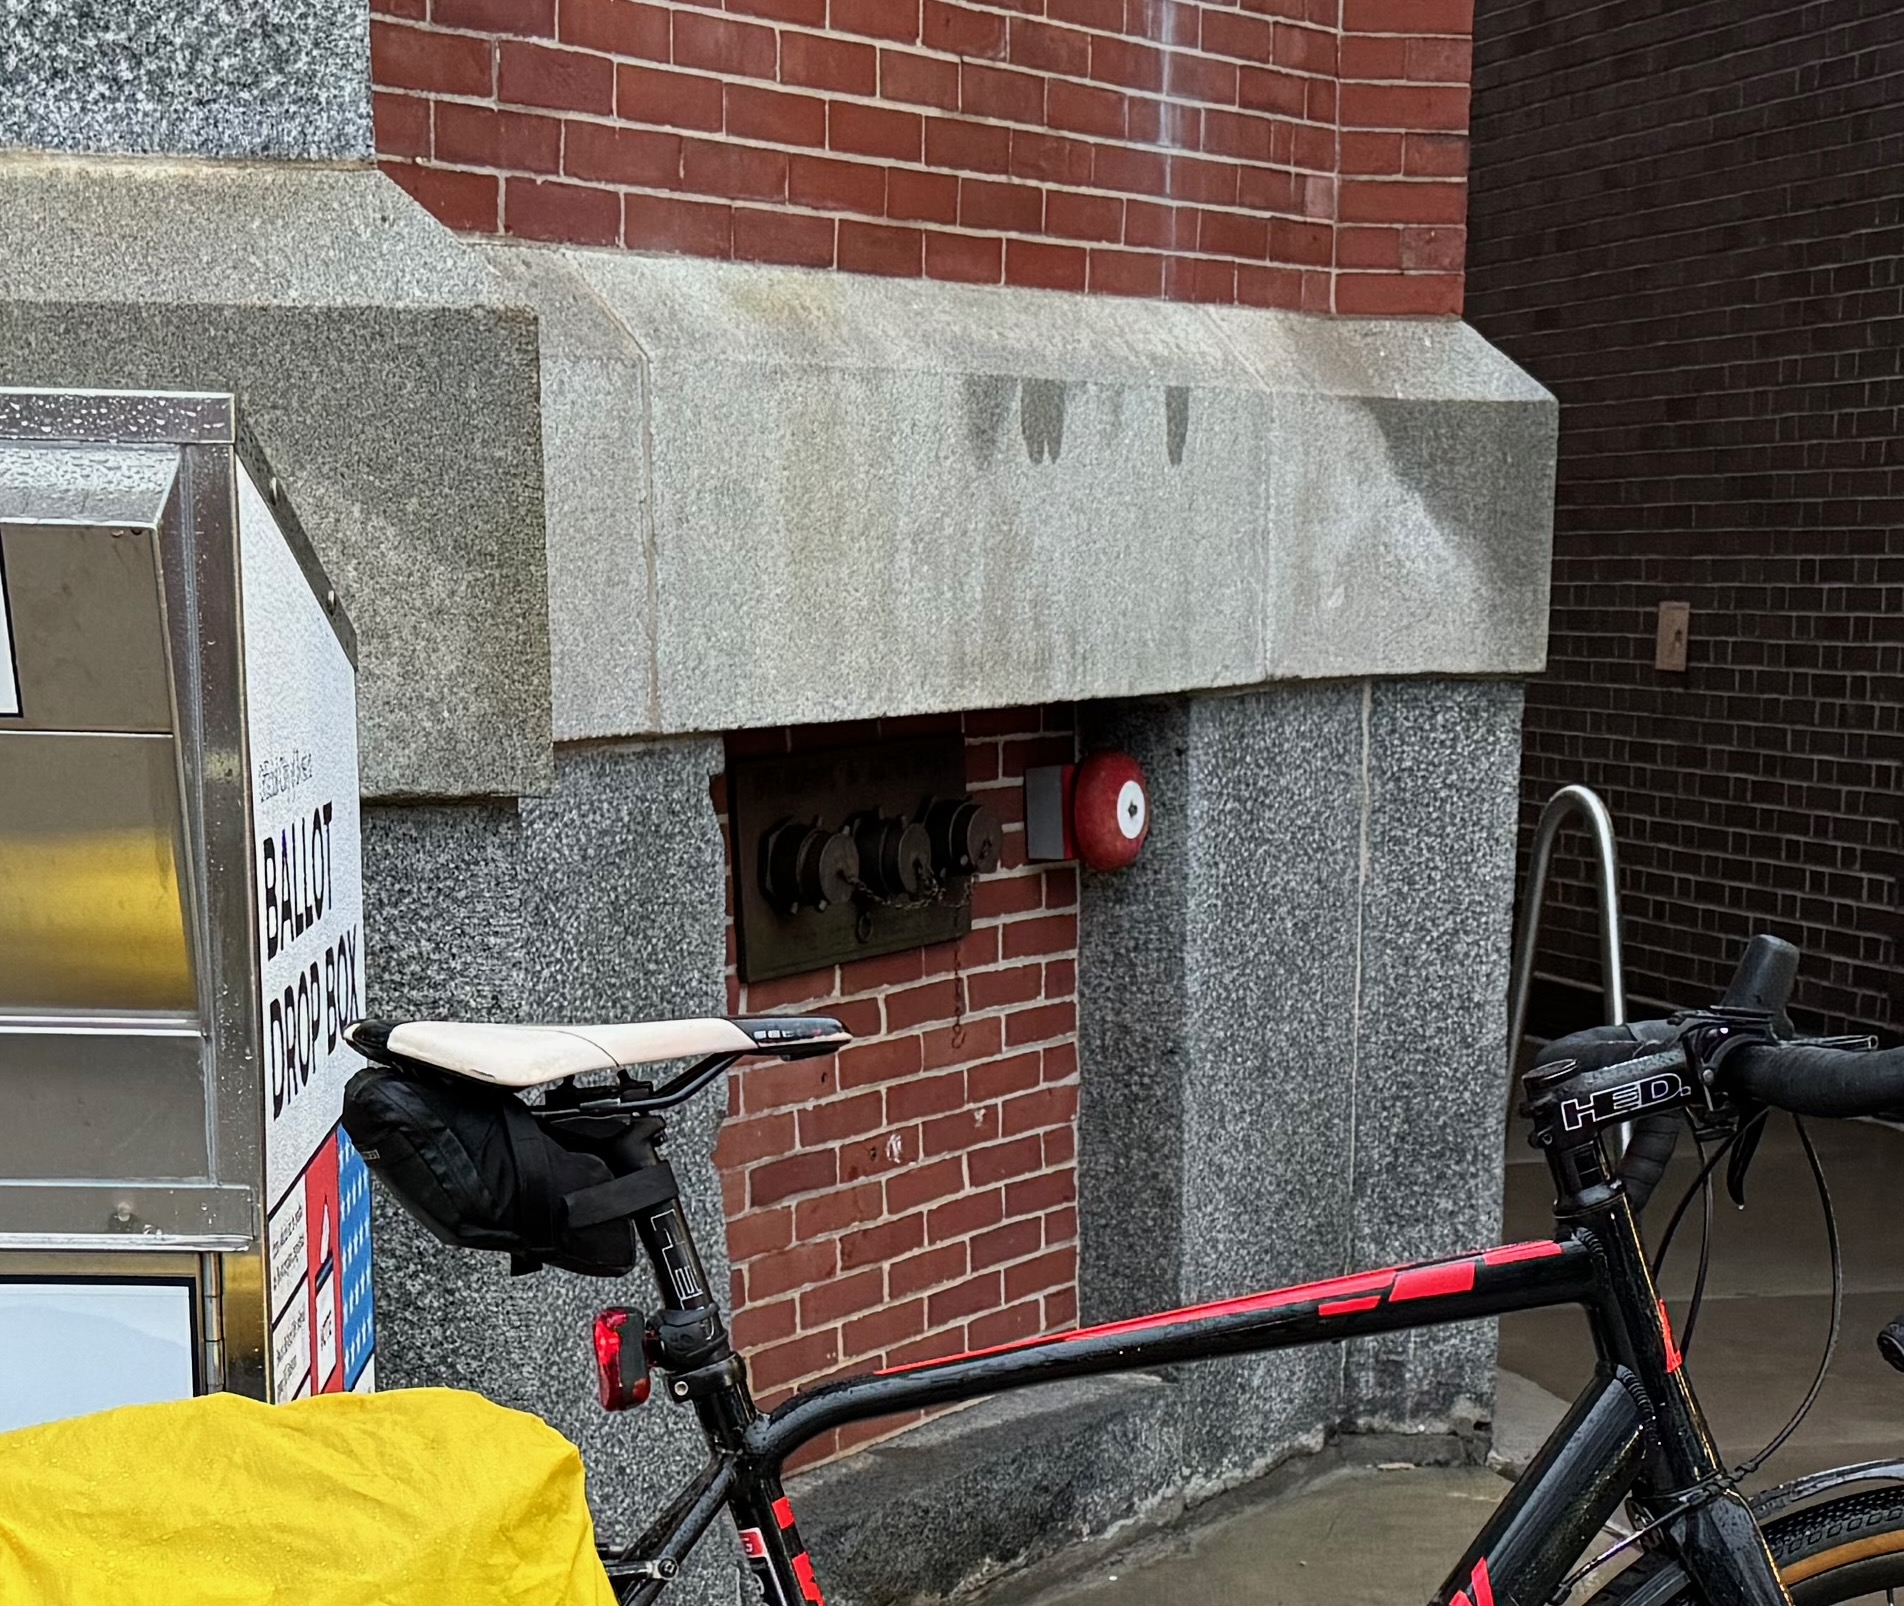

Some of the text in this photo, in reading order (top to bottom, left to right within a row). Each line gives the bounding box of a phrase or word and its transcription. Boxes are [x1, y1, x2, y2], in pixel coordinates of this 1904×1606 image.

[262, 801, 333, 962] BALLOT
[269, 923, 359, 1121] DROP BOX
